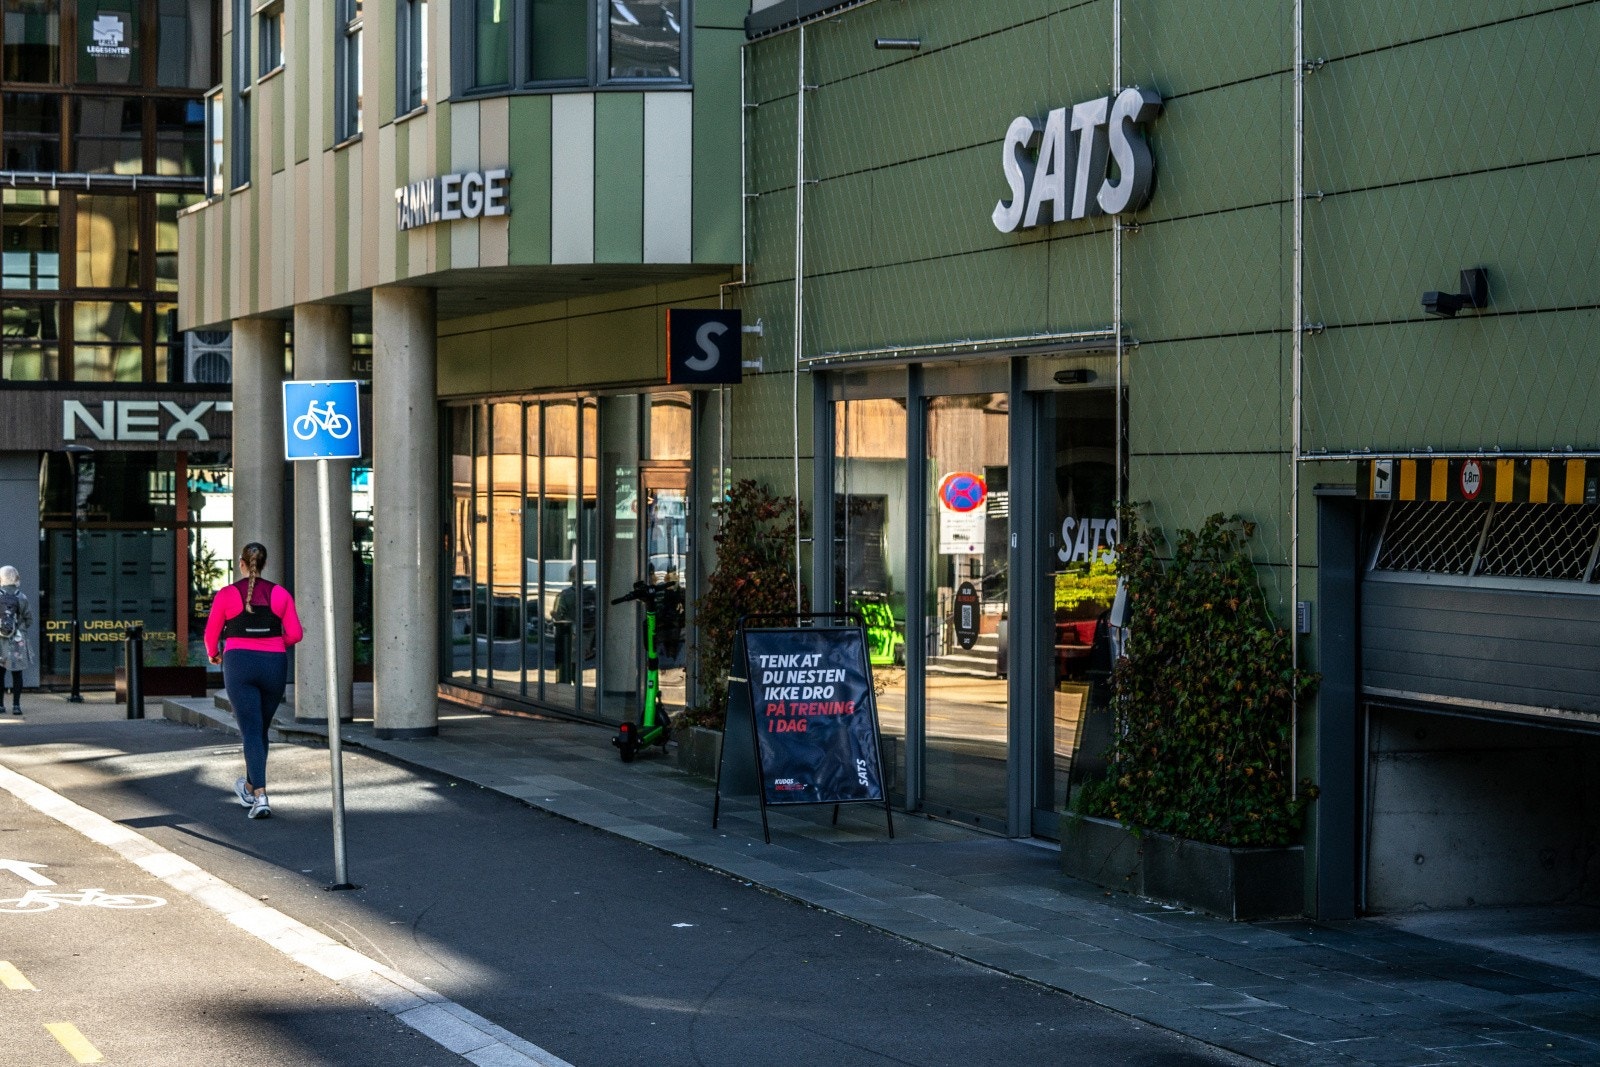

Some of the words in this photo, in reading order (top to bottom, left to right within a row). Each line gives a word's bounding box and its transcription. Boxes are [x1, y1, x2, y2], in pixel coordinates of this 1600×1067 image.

[991, 87, 1146, 233] SATS
[395, 168, 508, 232] TANNLEGE
[684, 321, 729, 372] S
[1057, 516, 1118, 565] SATS
[46, 620, 73, 630] DIT
[759, 654, 800, 669] TENK
[800, 653, 822, 668] AT
[762, 671, 784, 685] DU
[786, 669, 846, 684] NESTEN
[764, 686, 800, 701] IKKE
[802, 685, 835, 700] DRO
[766, 699, 786, 717] PÅ
[789, 701, 855, 716] TRENING
[768, 720, 774, 733] I
[776, 719, 808, 733] DAG
[856, 758, 868, 787] SATS
